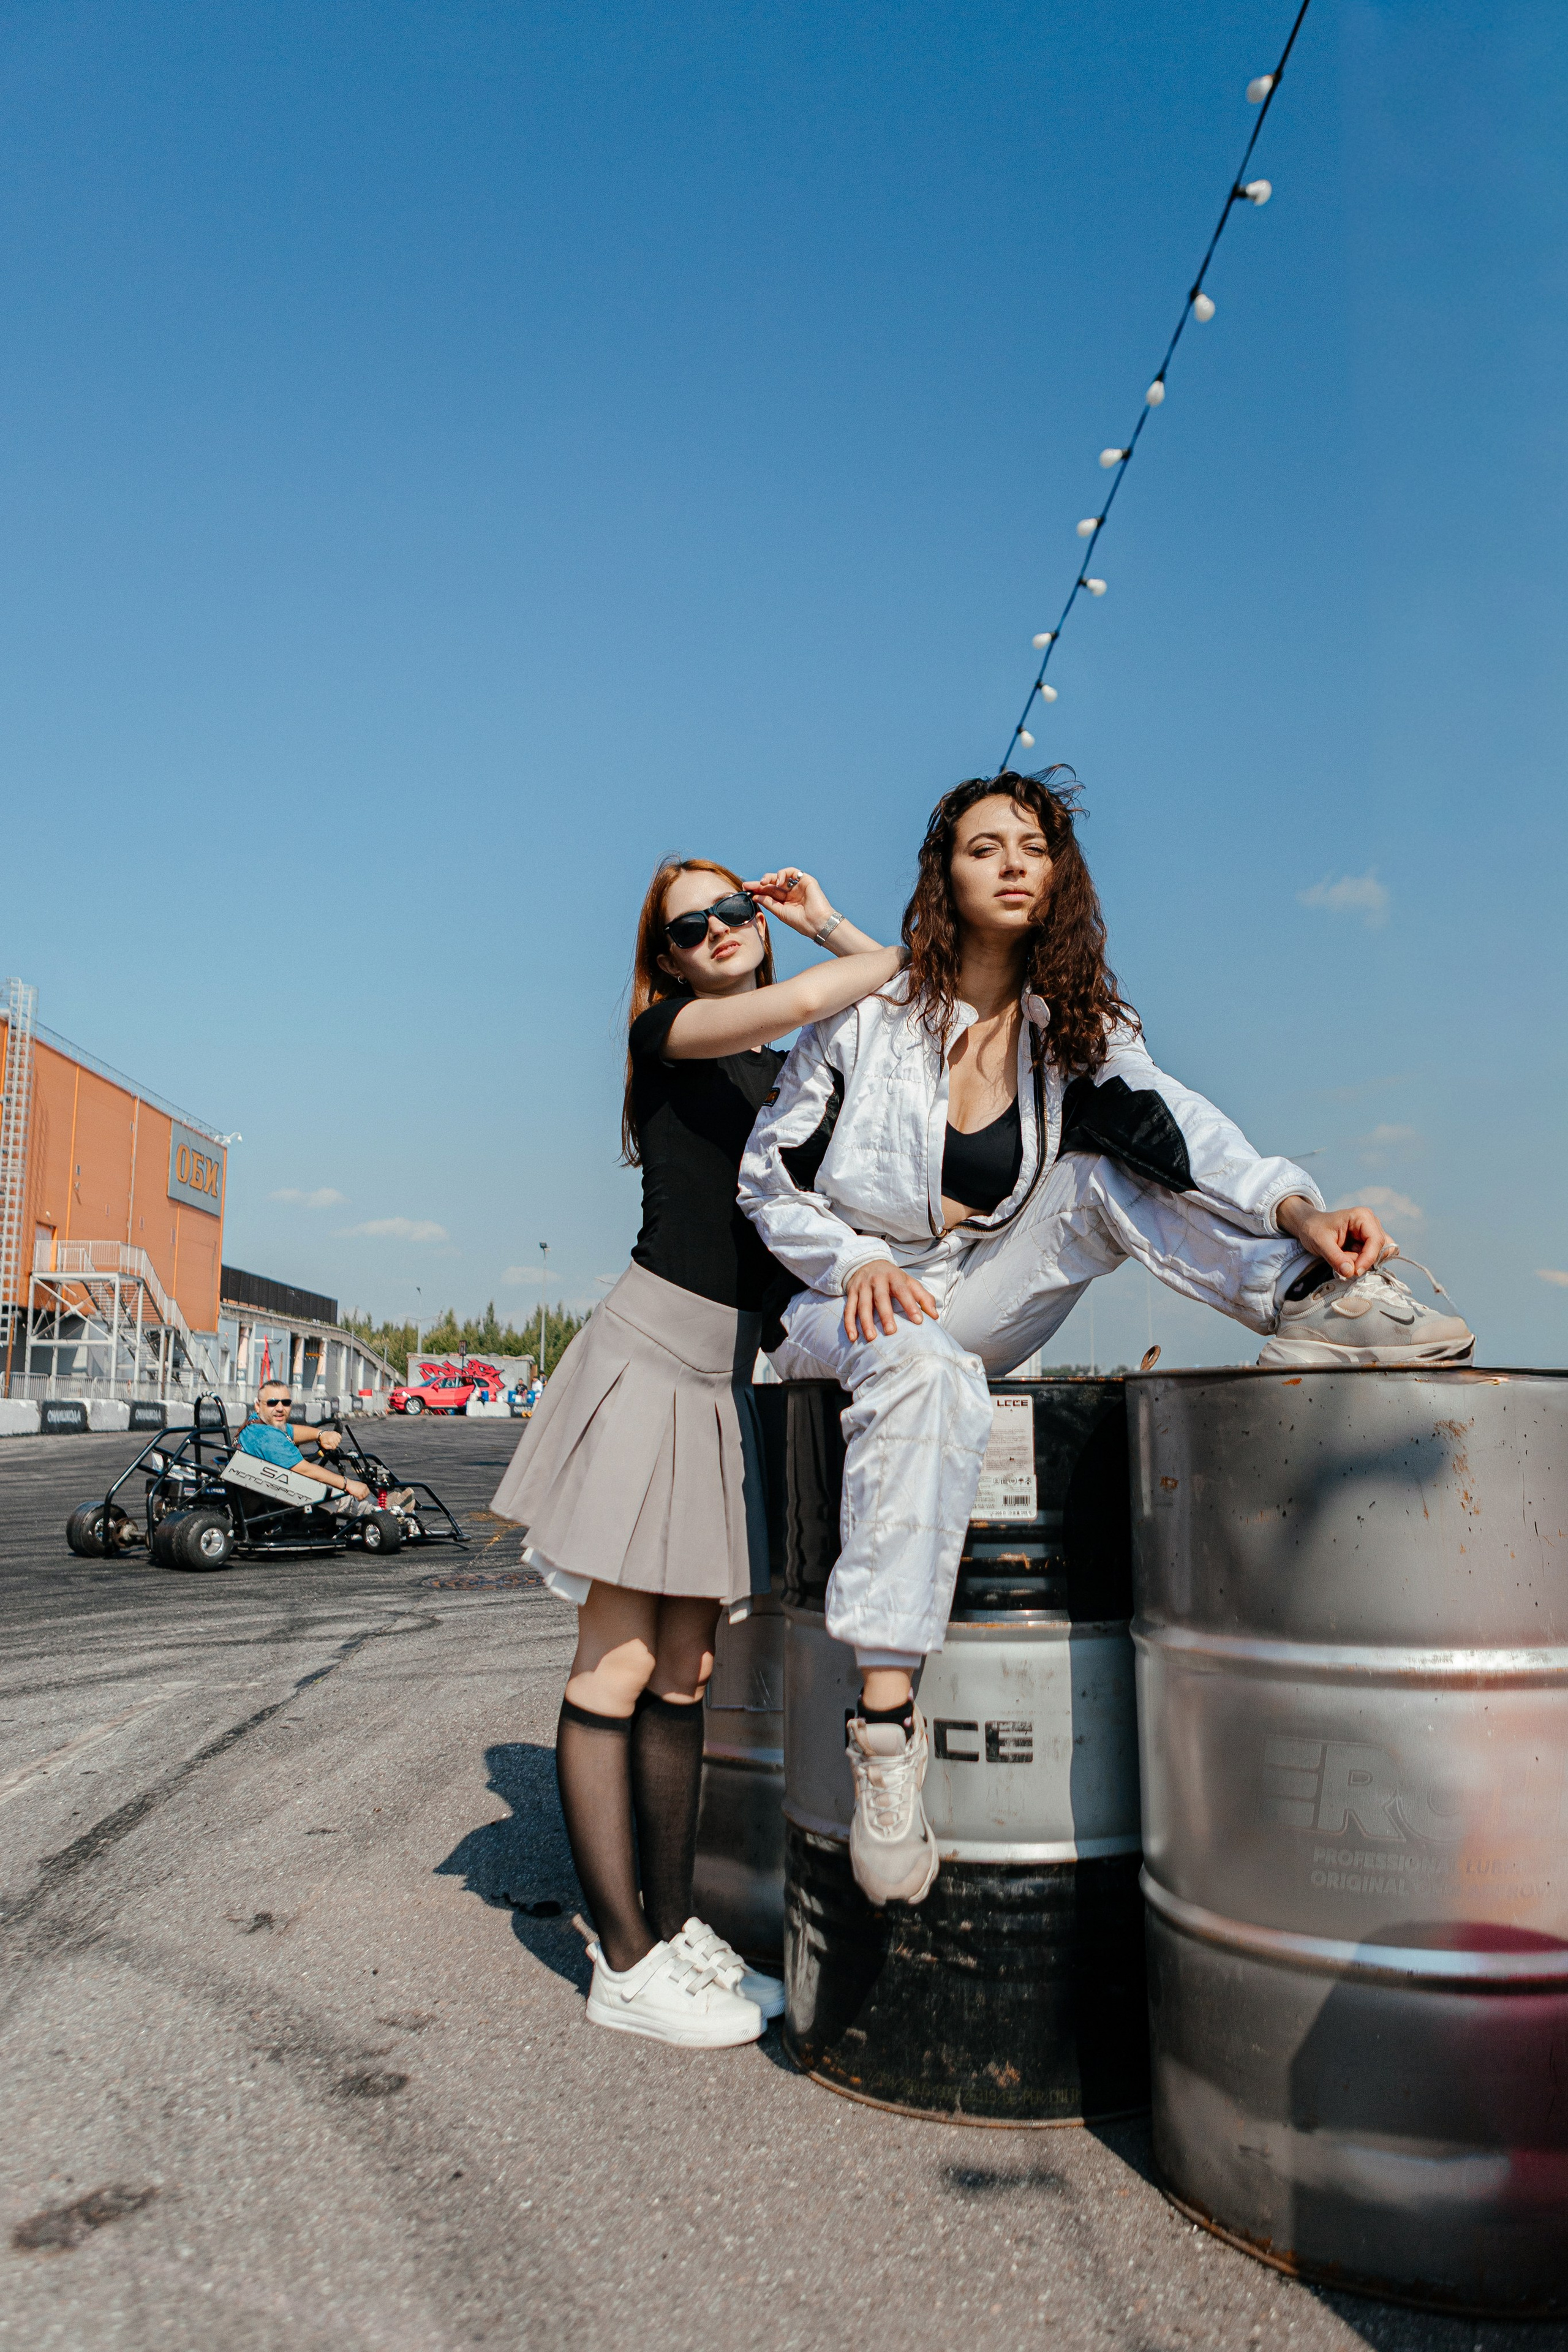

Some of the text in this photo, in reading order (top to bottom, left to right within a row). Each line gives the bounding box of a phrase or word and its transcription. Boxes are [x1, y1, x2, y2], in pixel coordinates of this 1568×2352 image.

[176, 1143, 219, 1197] ОБИ
[228, 1468, 312, 1501] MOTORSPORT
[260, 1466, 288, 1485] SA
[1310, 1869, 1409, 1897] ORIGINAL
